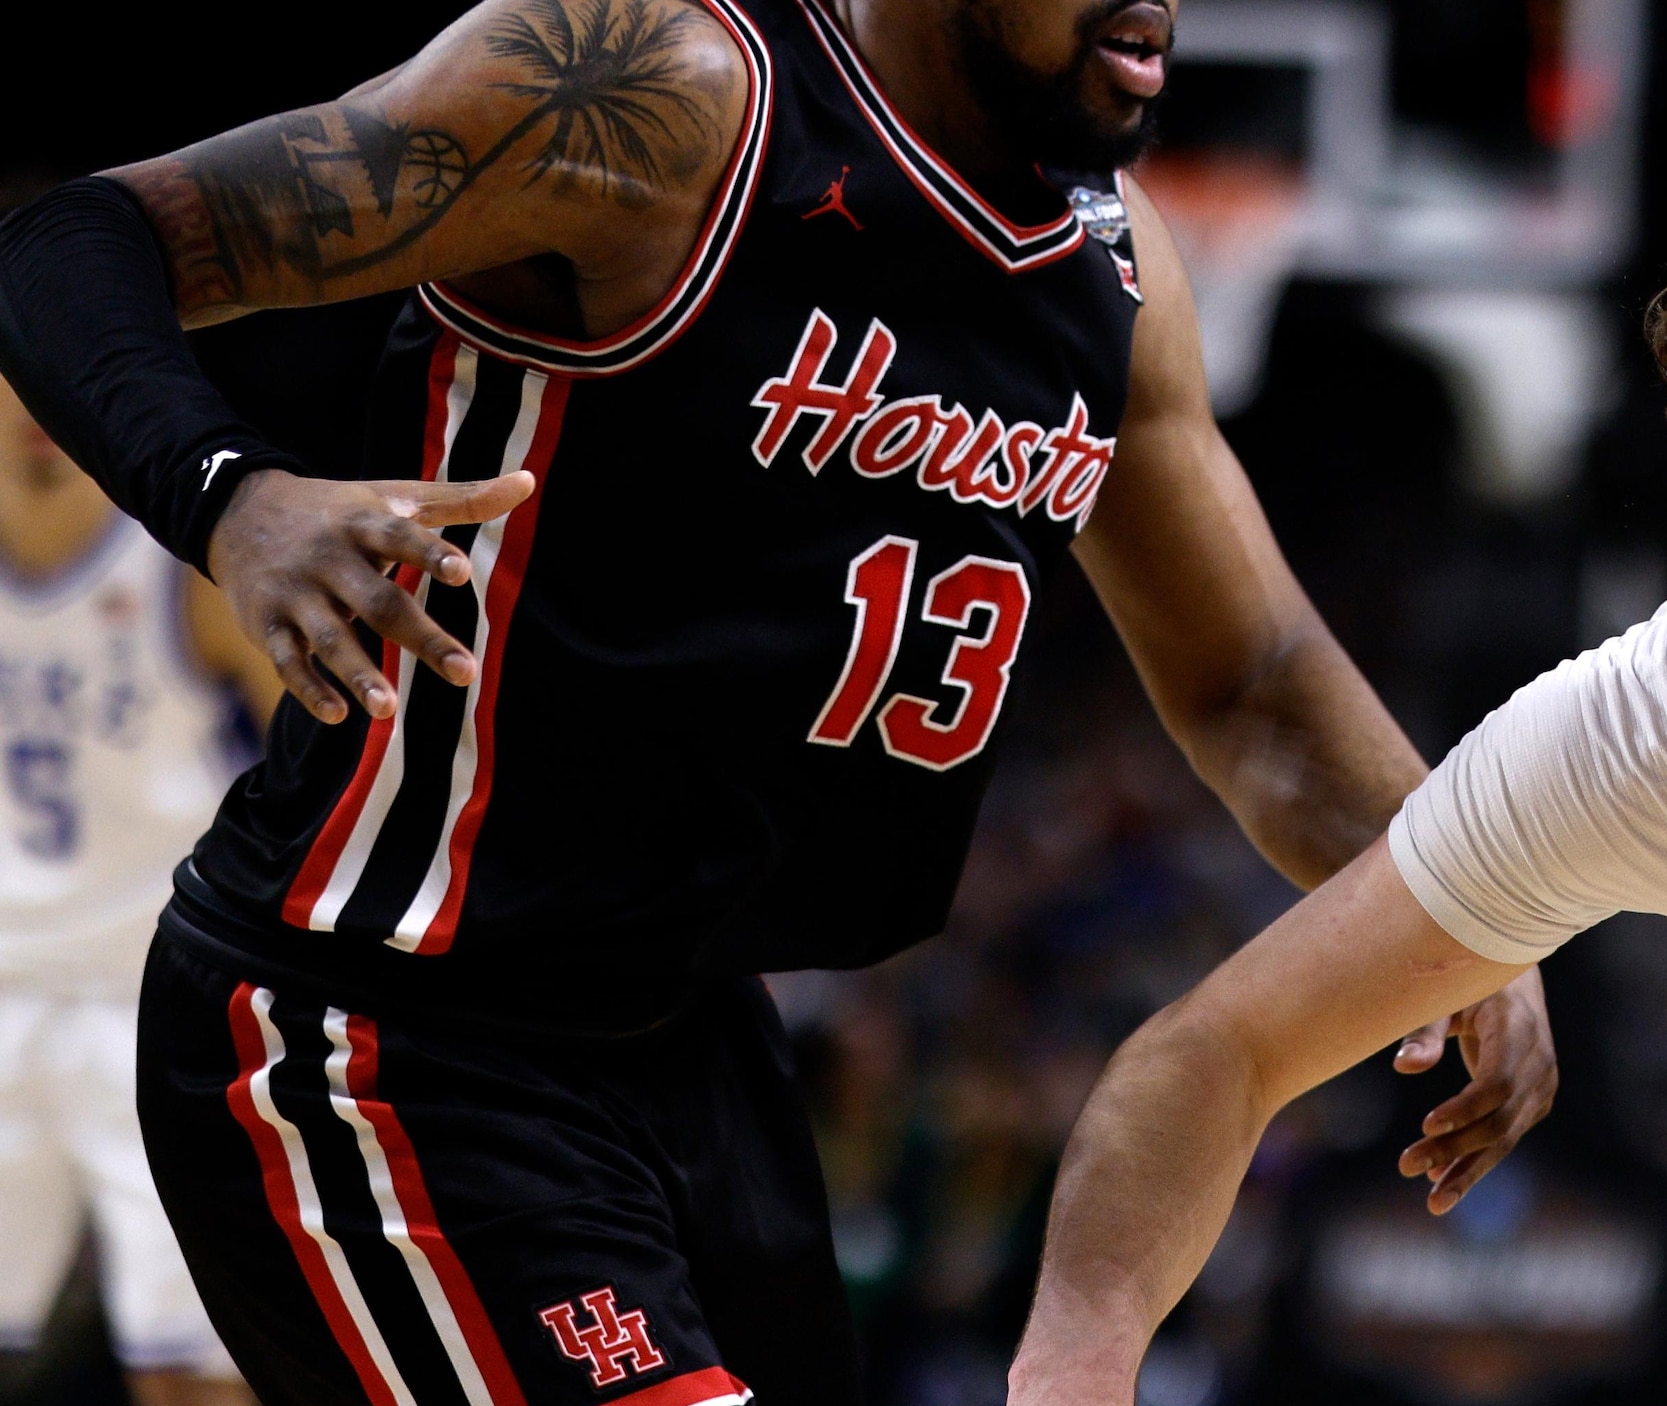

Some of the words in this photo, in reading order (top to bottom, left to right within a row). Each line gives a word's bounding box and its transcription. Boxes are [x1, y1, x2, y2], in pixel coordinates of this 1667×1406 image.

[750, 306, 1117, 533] Housto
[806, 534, 1031, 772] 13
[538, 1287, 666, 1387] UH
